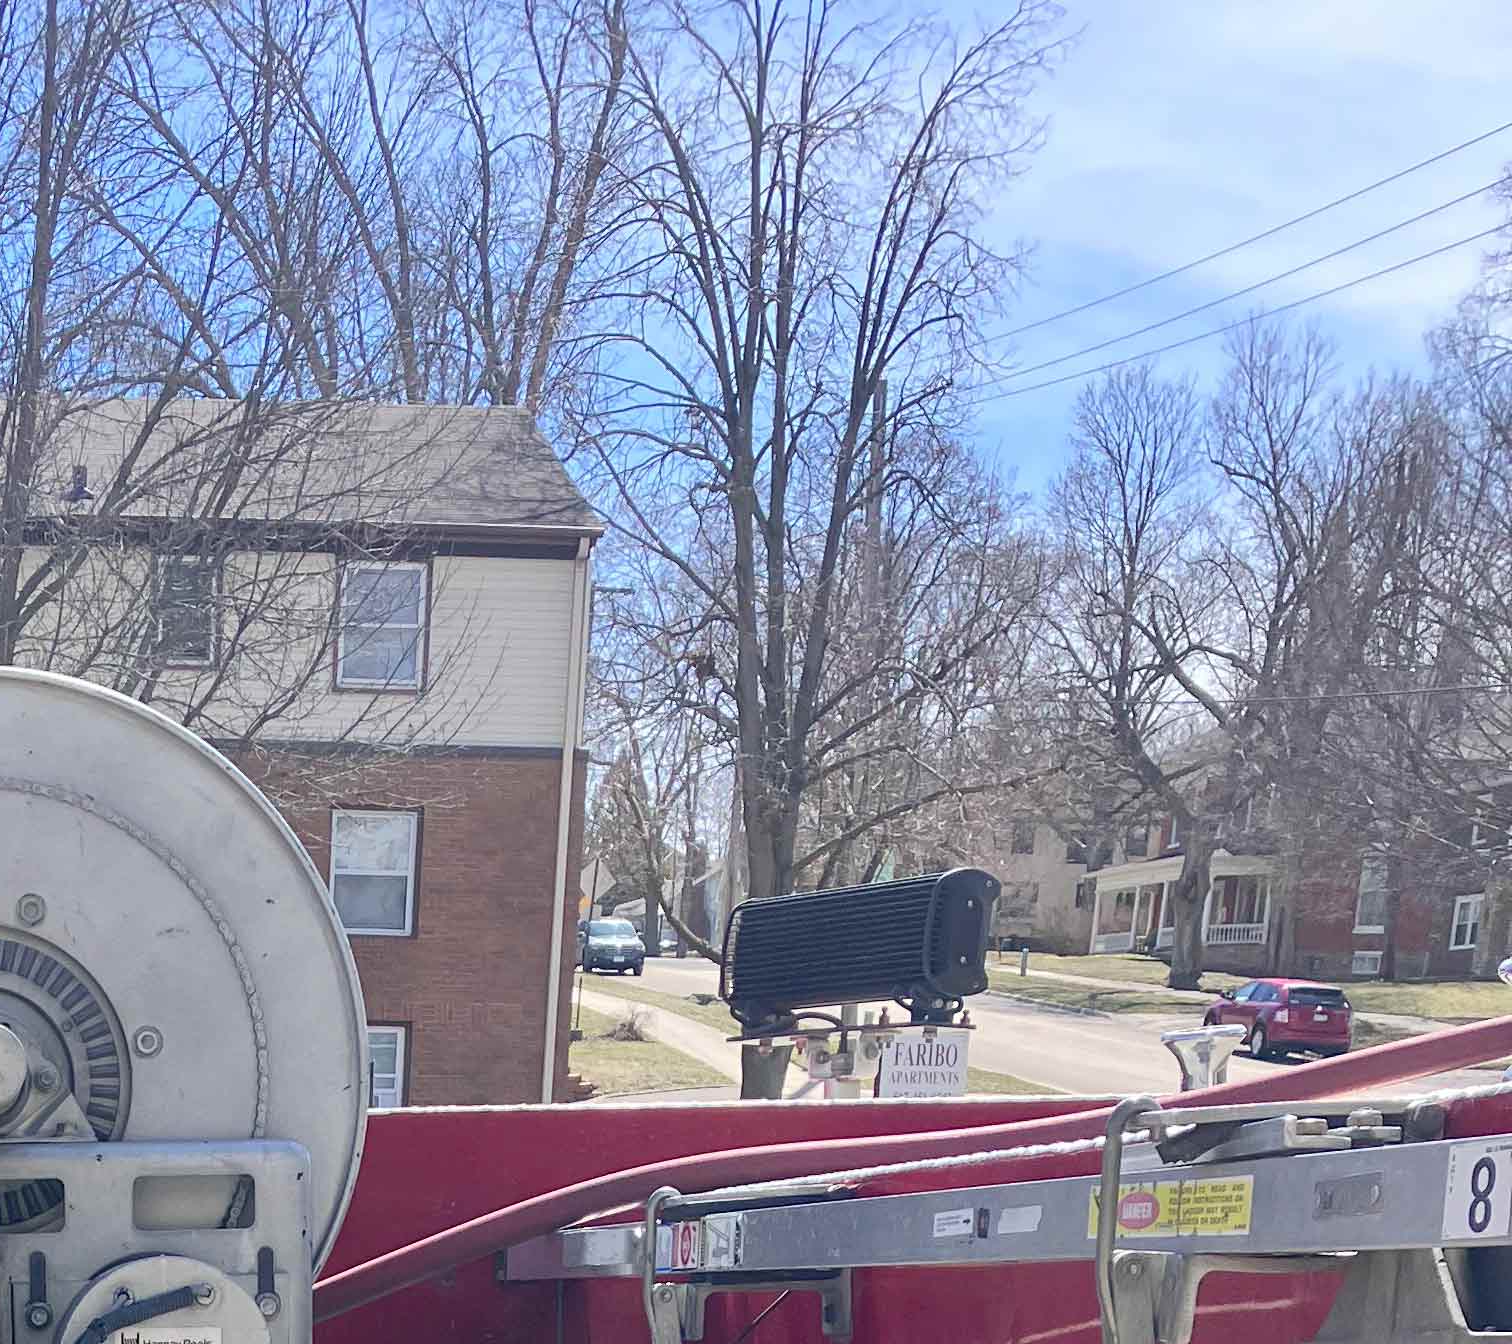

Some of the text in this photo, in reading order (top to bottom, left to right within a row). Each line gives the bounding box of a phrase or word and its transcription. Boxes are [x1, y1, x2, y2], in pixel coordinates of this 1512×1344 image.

[893, 1042, 958, 1068] FARIBO
[890, 1070, 960, 1086] APARTMENTS
[1468, 1156, 1497, 1234] 8
